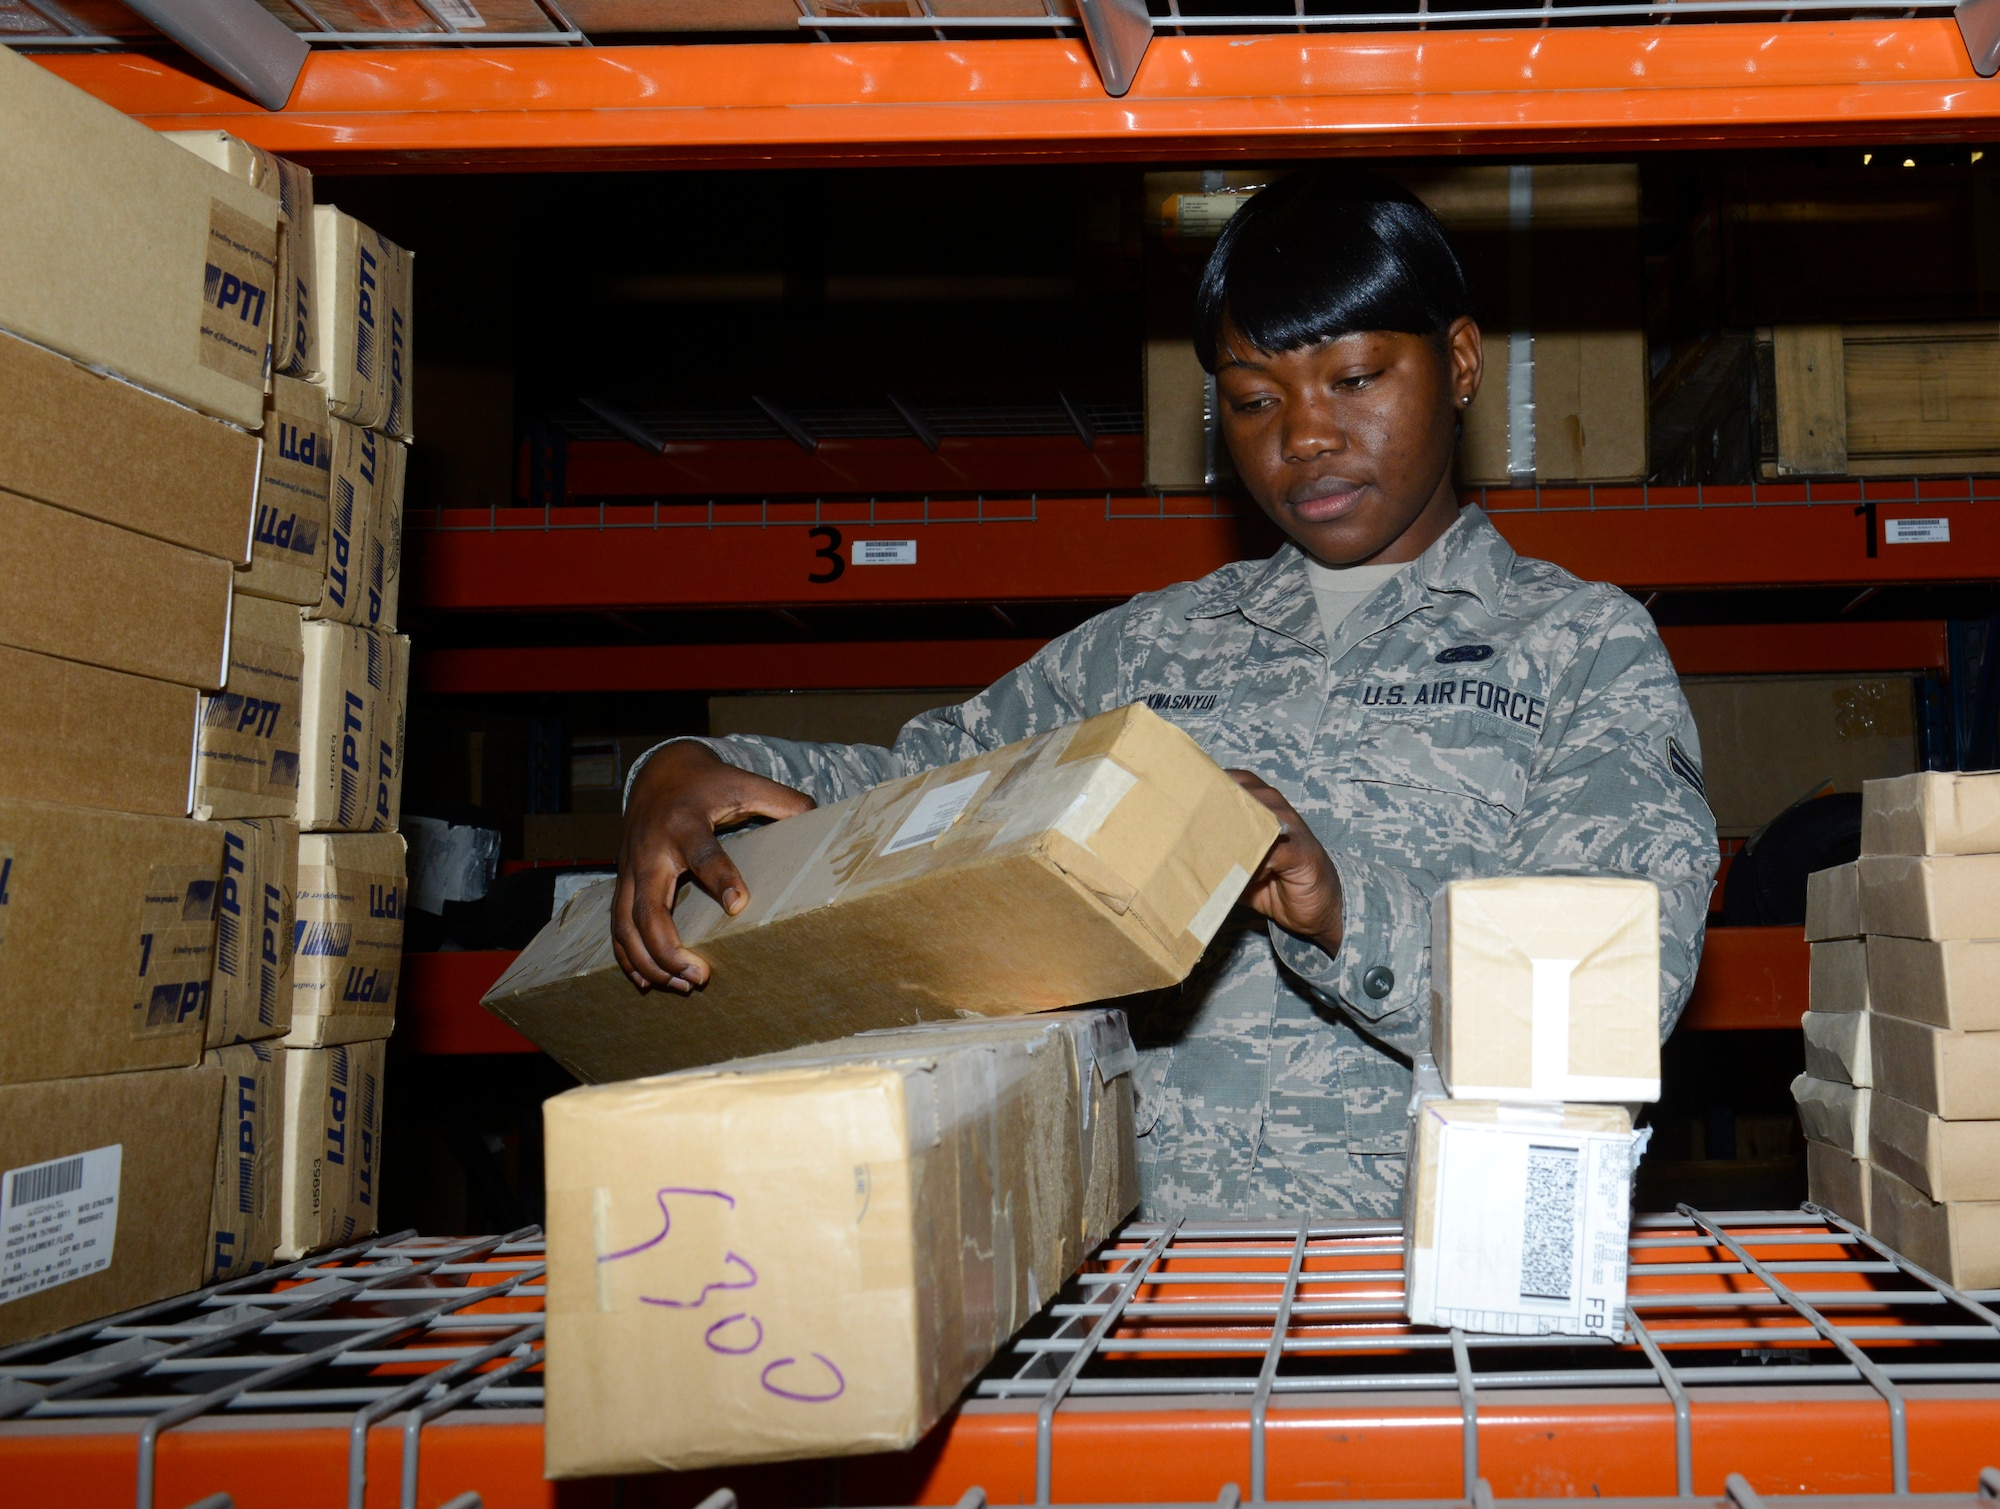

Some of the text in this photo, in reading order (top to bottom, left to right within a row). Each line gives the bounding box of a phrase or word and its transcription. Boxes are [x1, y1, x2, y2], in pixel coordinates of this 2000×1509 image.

[217, 272, 266, 328] PTI
[359, 246, 376, 329] PTI
[296, 277, 308, 359] PTI
[392, 308, 402, 386] PTI
[280, 422, 316, 466] PTI
[254, 504, 296, 550] PTI
[808, 527, 845, 583] 3
[1854, 504, 1877, 558] 1
[329, 528, 350, 608] PTI
[236, 696, 281, 738] PTI
[1136, 693, 1218, 710] KWASINYUI
[1362, 680, 1546, 728] U.S. AIR FORCE
[342, 690, 364, 772] PTI
[377, 740, 392, 820] PTI
[222, 831, 244, 916] PTI
[370, 884, 397, 919] PTI
[262, 882, 280, 966] PTI
[342, 966, 378, 1003] PTI
[238, 1076, 256, 1154] PTI
[328, 1086, 347, 1166] PTI
[313, 1158, 322, 1216] 165953
[360, 1128, 373, 1206] PTI
[1585, 1298, 1605, 1336] FB
